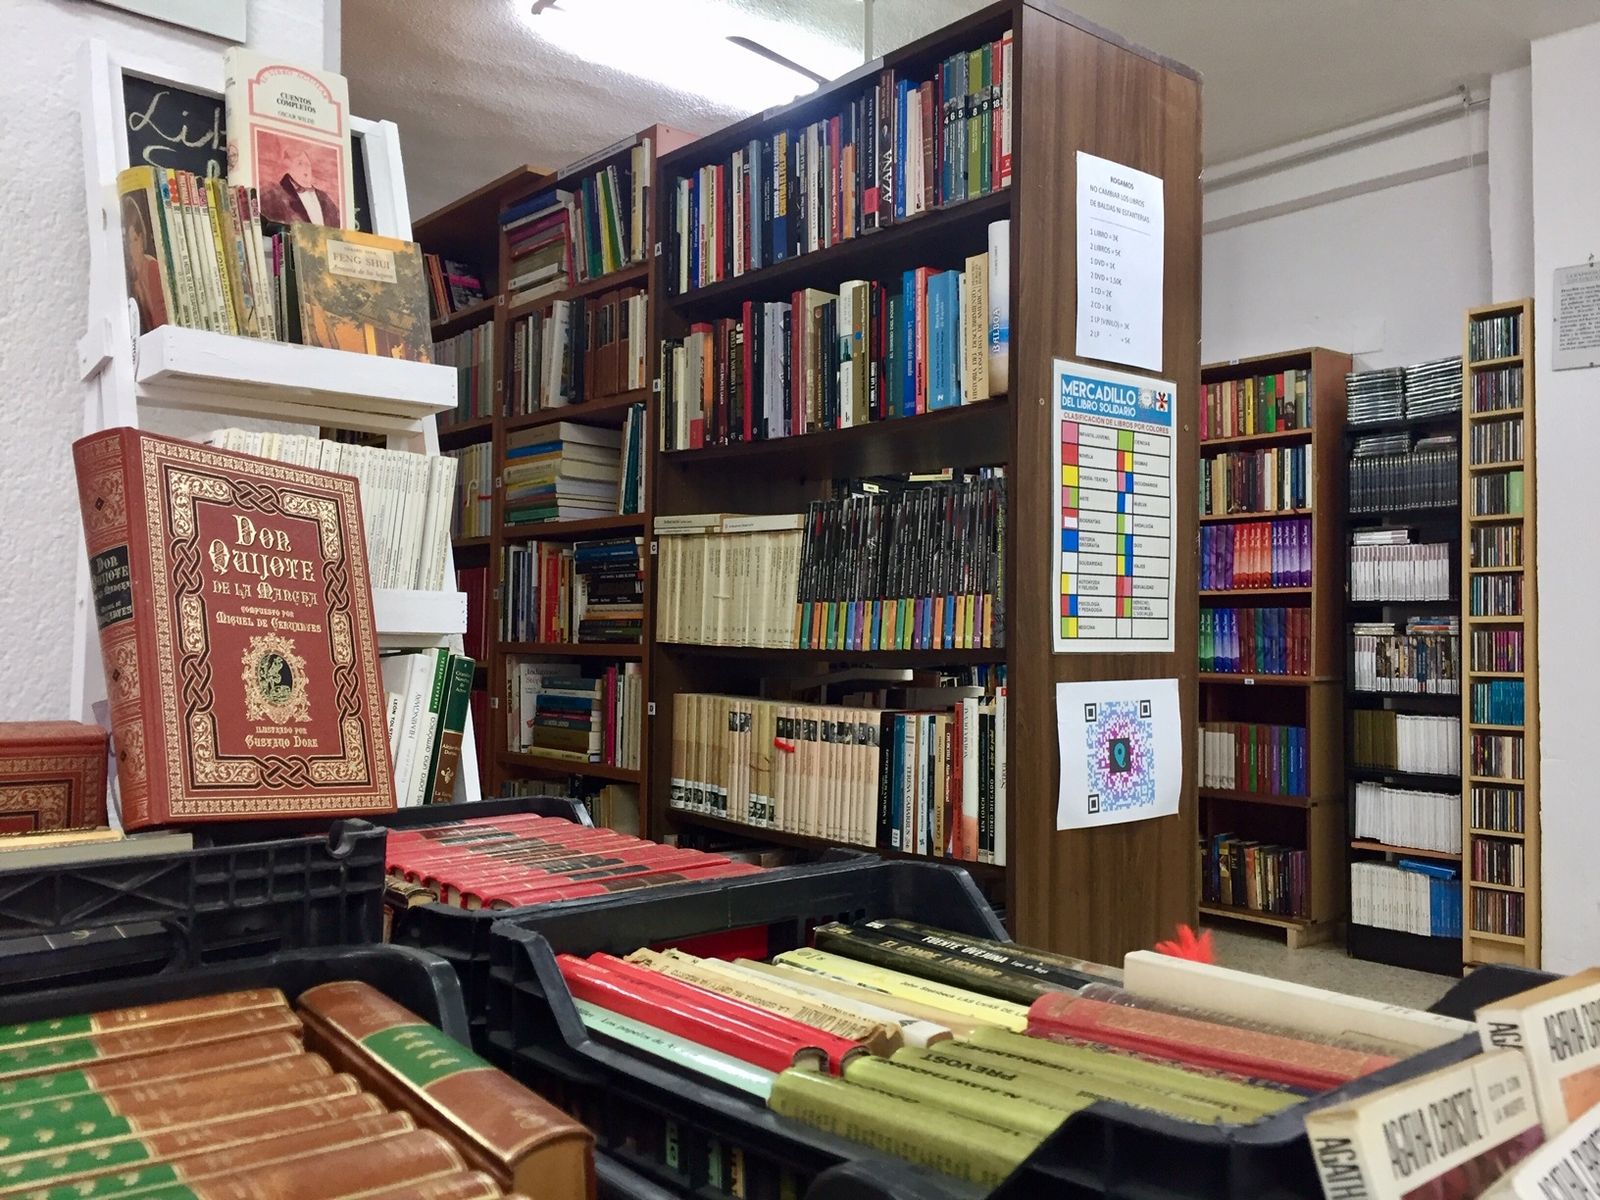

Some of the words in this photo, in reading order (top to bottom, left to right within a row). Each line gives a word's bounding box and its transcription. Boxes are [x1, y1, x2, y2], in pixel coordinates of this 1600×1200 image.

[277, 98, 316, 113] COMPLETOS
[280, 92, 311, 105] CUENTOS
[1090, 185, 1098, 193] NO
[1110, 176, 1134, 190] ROGAMOS
[1090, 199, 1097, 207] DE
[333, 253, 361, 264] FENG
[366, 258, 390, 269] SHUI
[1094, 258, 1105, 268] DVD
[1094, 273, 1105, 282] DVD
[1094, 288, 1101, 296] CD
[1094, 302, 1101, 310] CD
[992, 308, 1000, 352] BALBOA
[1062, 380, 1136, 406] MERCADILLO
[1062, 397, 1075, 407] DEL
[1077, 400, 1097, 411] LIBRO
[1099, 403, 1136, 417] SOLIDARIO
[1114, 420, 1133, 430] LIBROS
[1134, 423, 1144, 431] POR
[1145, 424, 1169, 435] COLORES
[433, 682, 442, 709] BARBARA
[408, 692, 422, 739] HEMINGWAY
[418, 773, 427, 792] para
[423, 717, 437, 752] armónica
[880, 940, 892, 948] EL
[896, 943, 943, 962] CONDE
[922, 934, 960, 950] FUENTE
[961, 944, 1009, 964] OVEJUNA
[920, 1053, 1016, 1082] PREVOST
[1314, 1137, 1369, 1200] AGATH
